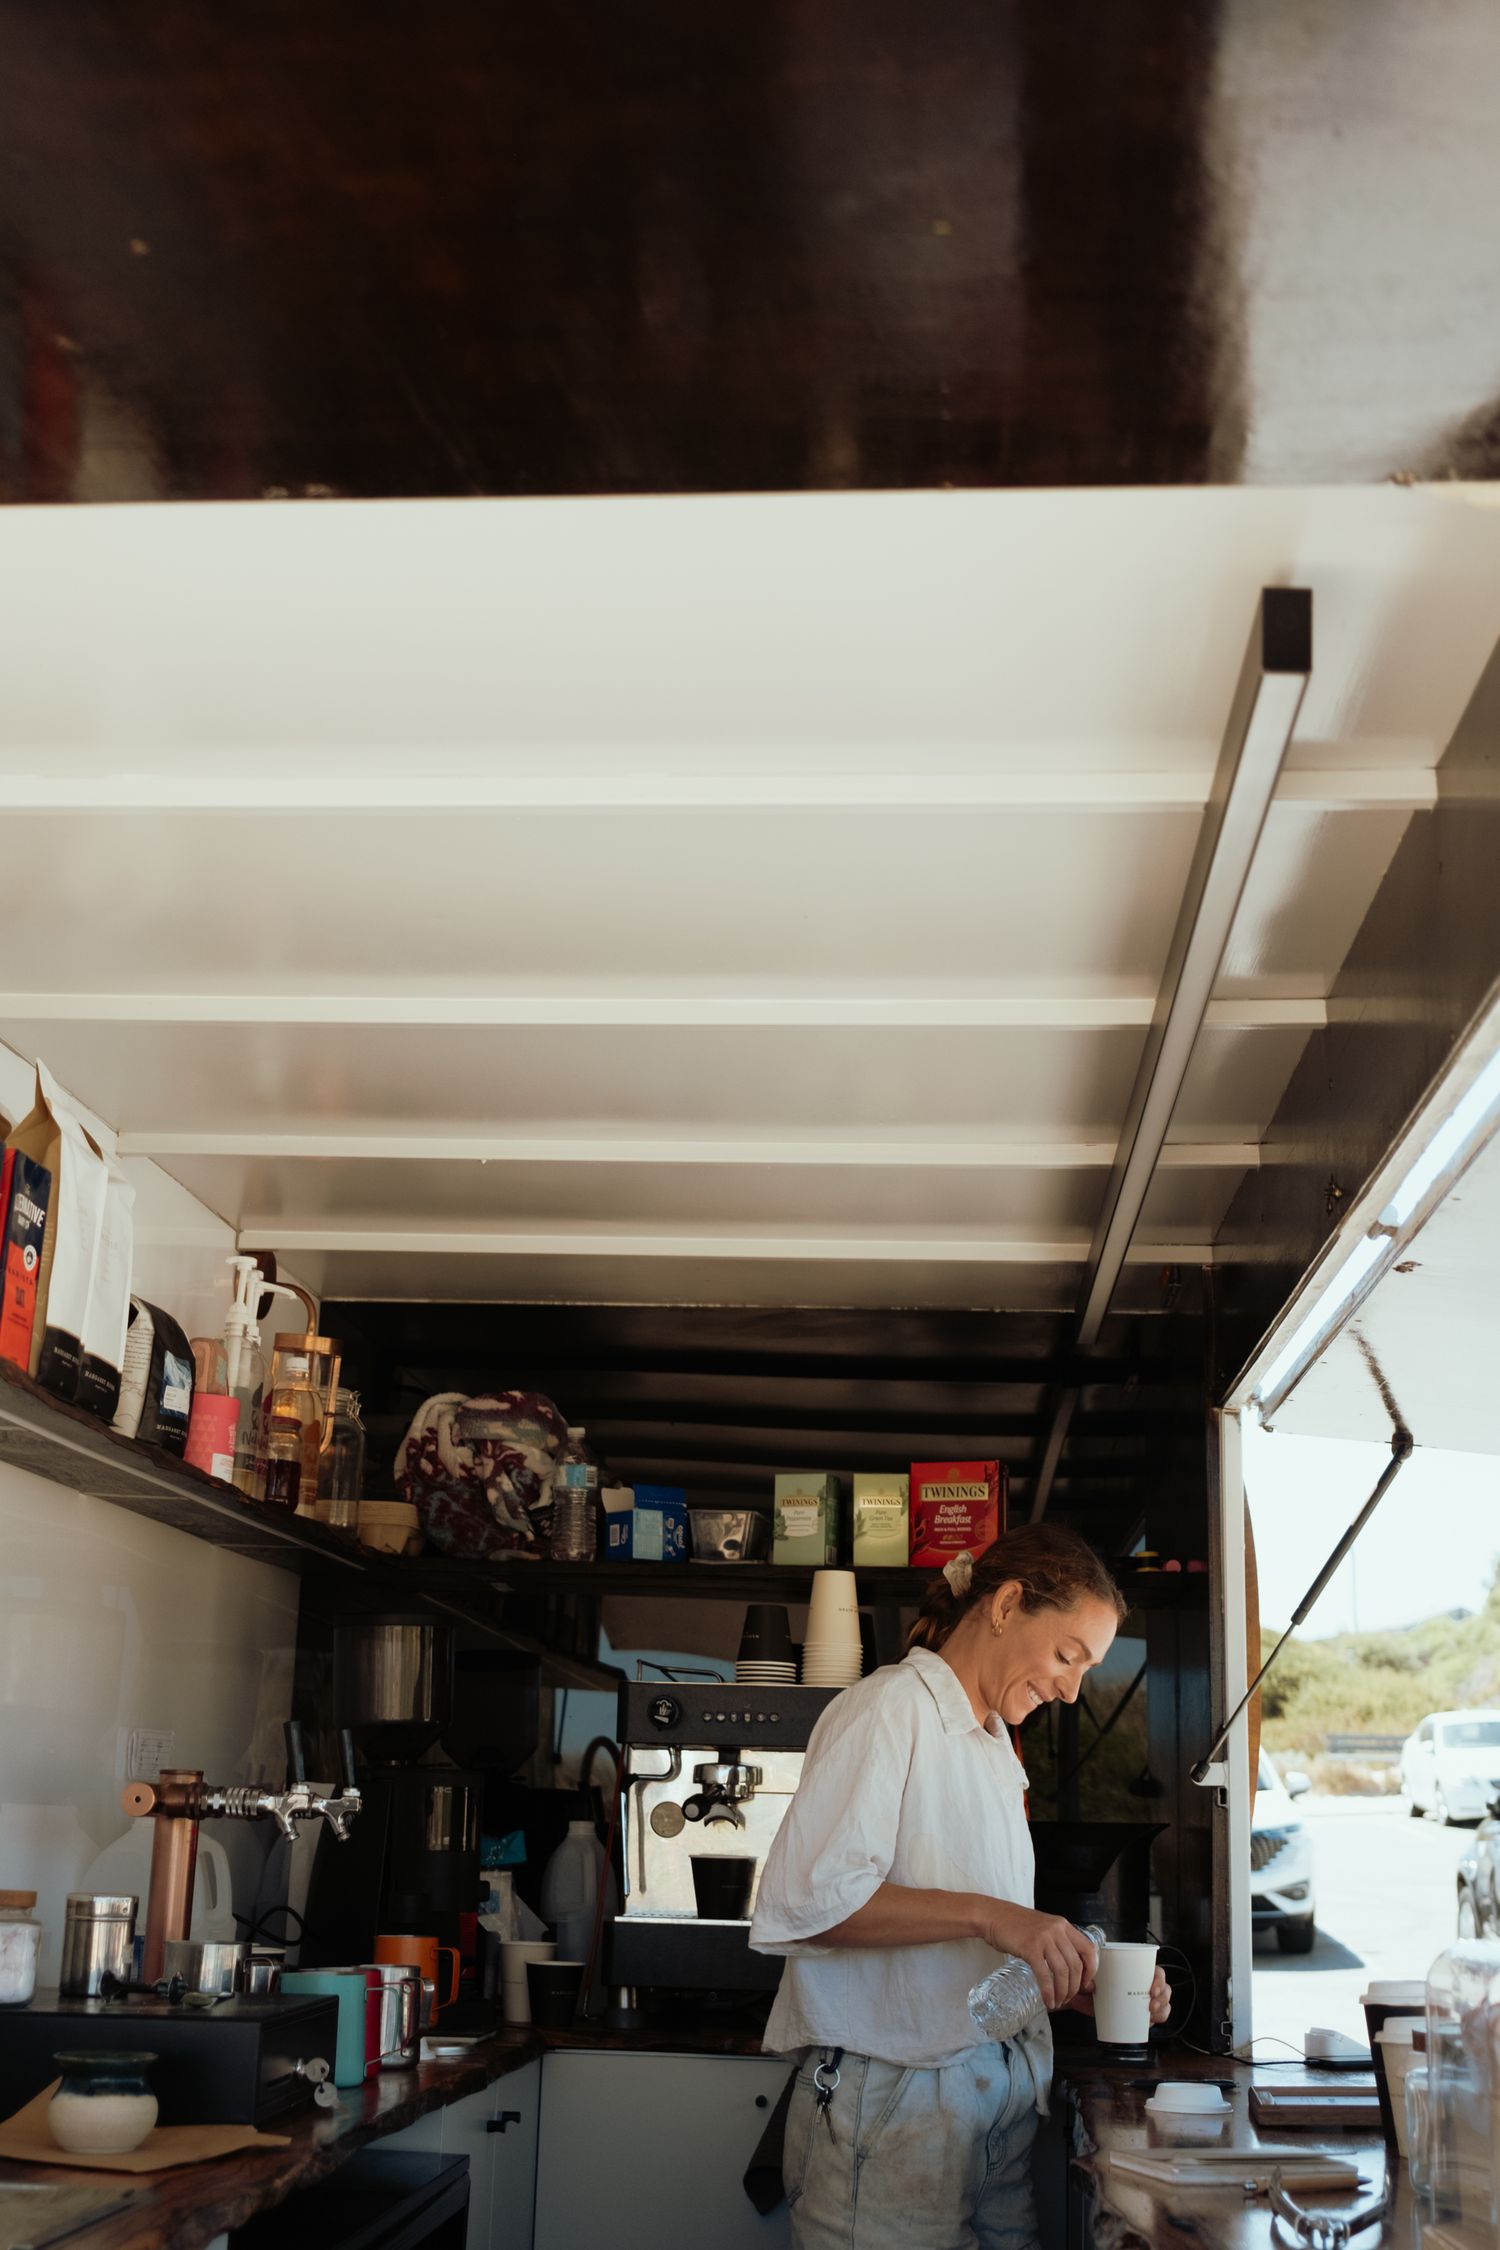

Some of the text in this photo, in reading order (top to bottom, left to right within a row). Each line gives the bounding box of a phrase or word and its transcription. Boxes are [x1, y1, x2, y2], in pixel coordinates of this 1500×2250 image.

[923, 1486, 985, 1498] TWININGS
[782, 1498, 818, 1507] TWININGS
[939, 1504, 968, 1515] English
[934, 1515, 972, 1525] Breakfast
